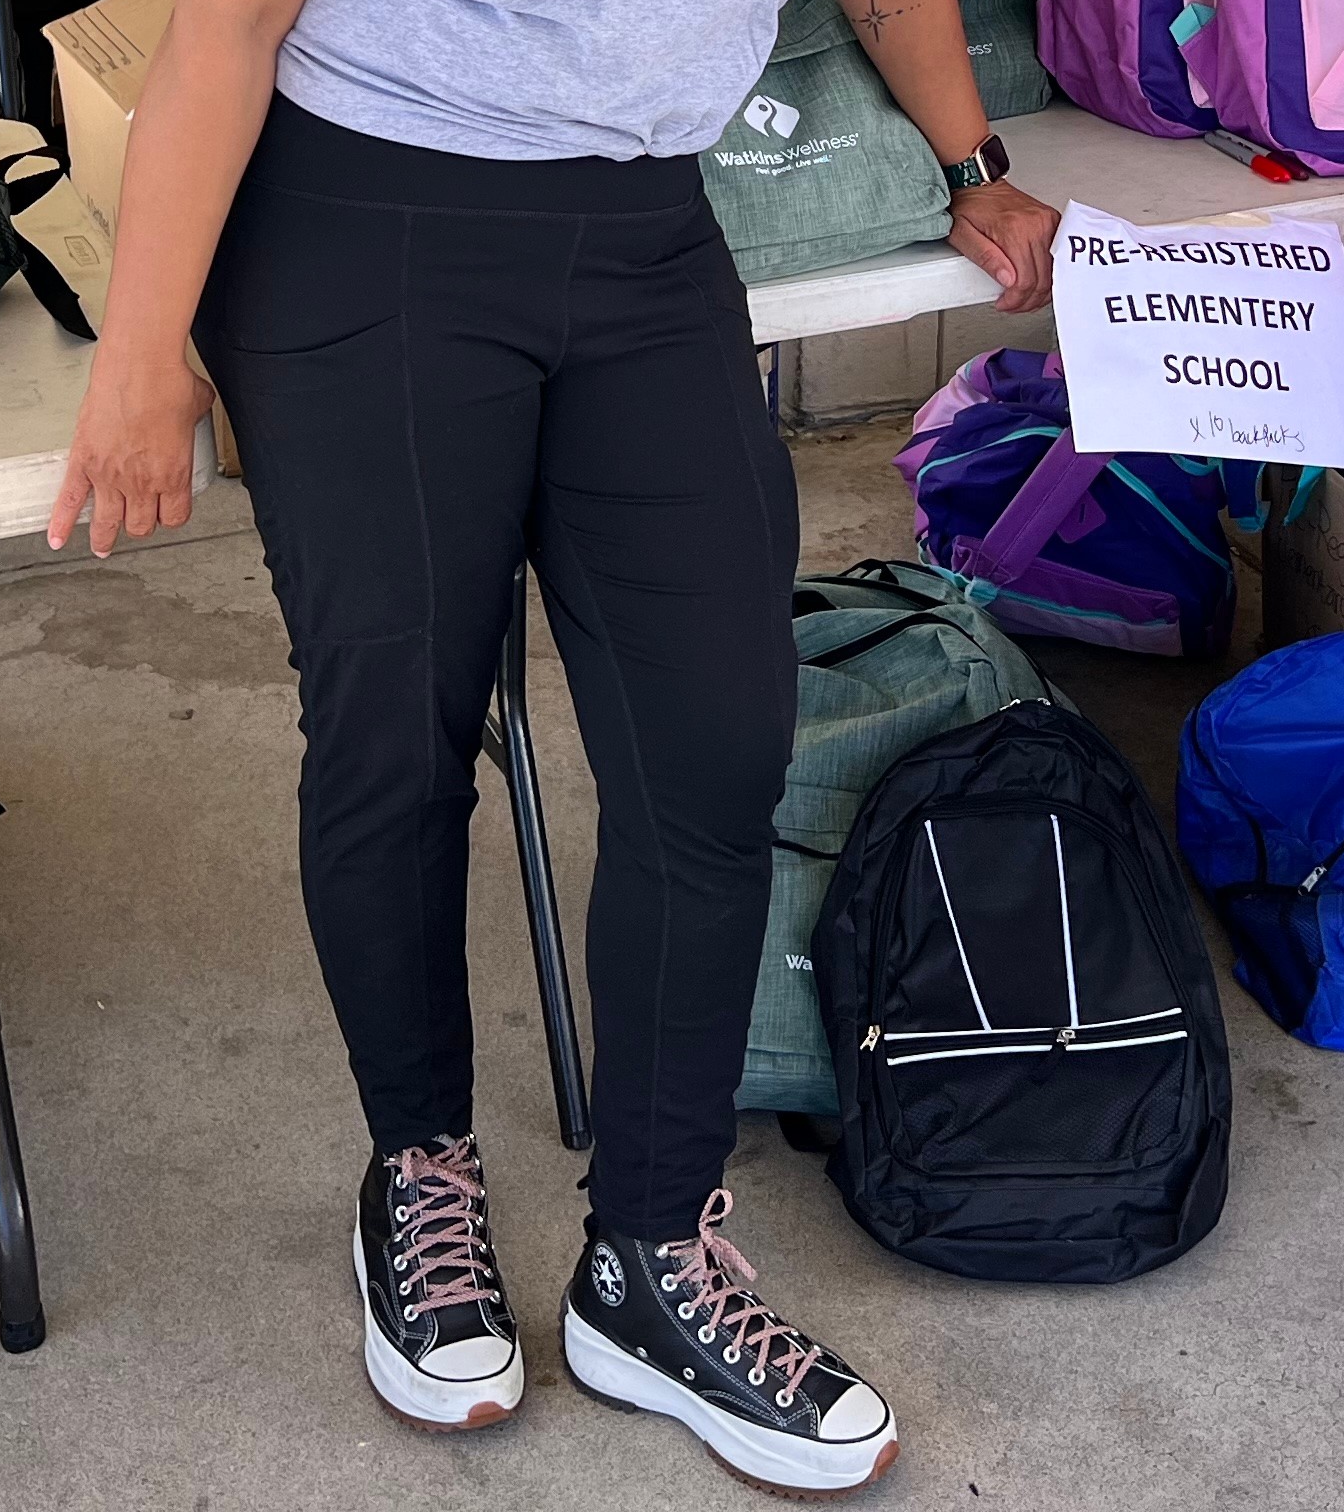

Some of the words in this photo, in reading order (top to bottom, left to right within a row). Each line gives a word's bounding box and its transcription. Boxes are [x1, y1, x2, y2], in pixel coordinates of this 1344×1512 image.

[1068, 235, 1331, 272] PRE-REGISTERED
[1105, 294, 1315, 332] ELEMENTERY
[1163, 354, 1290, 392] SCHOOL
[1208, 410, 1224, 438] 10
